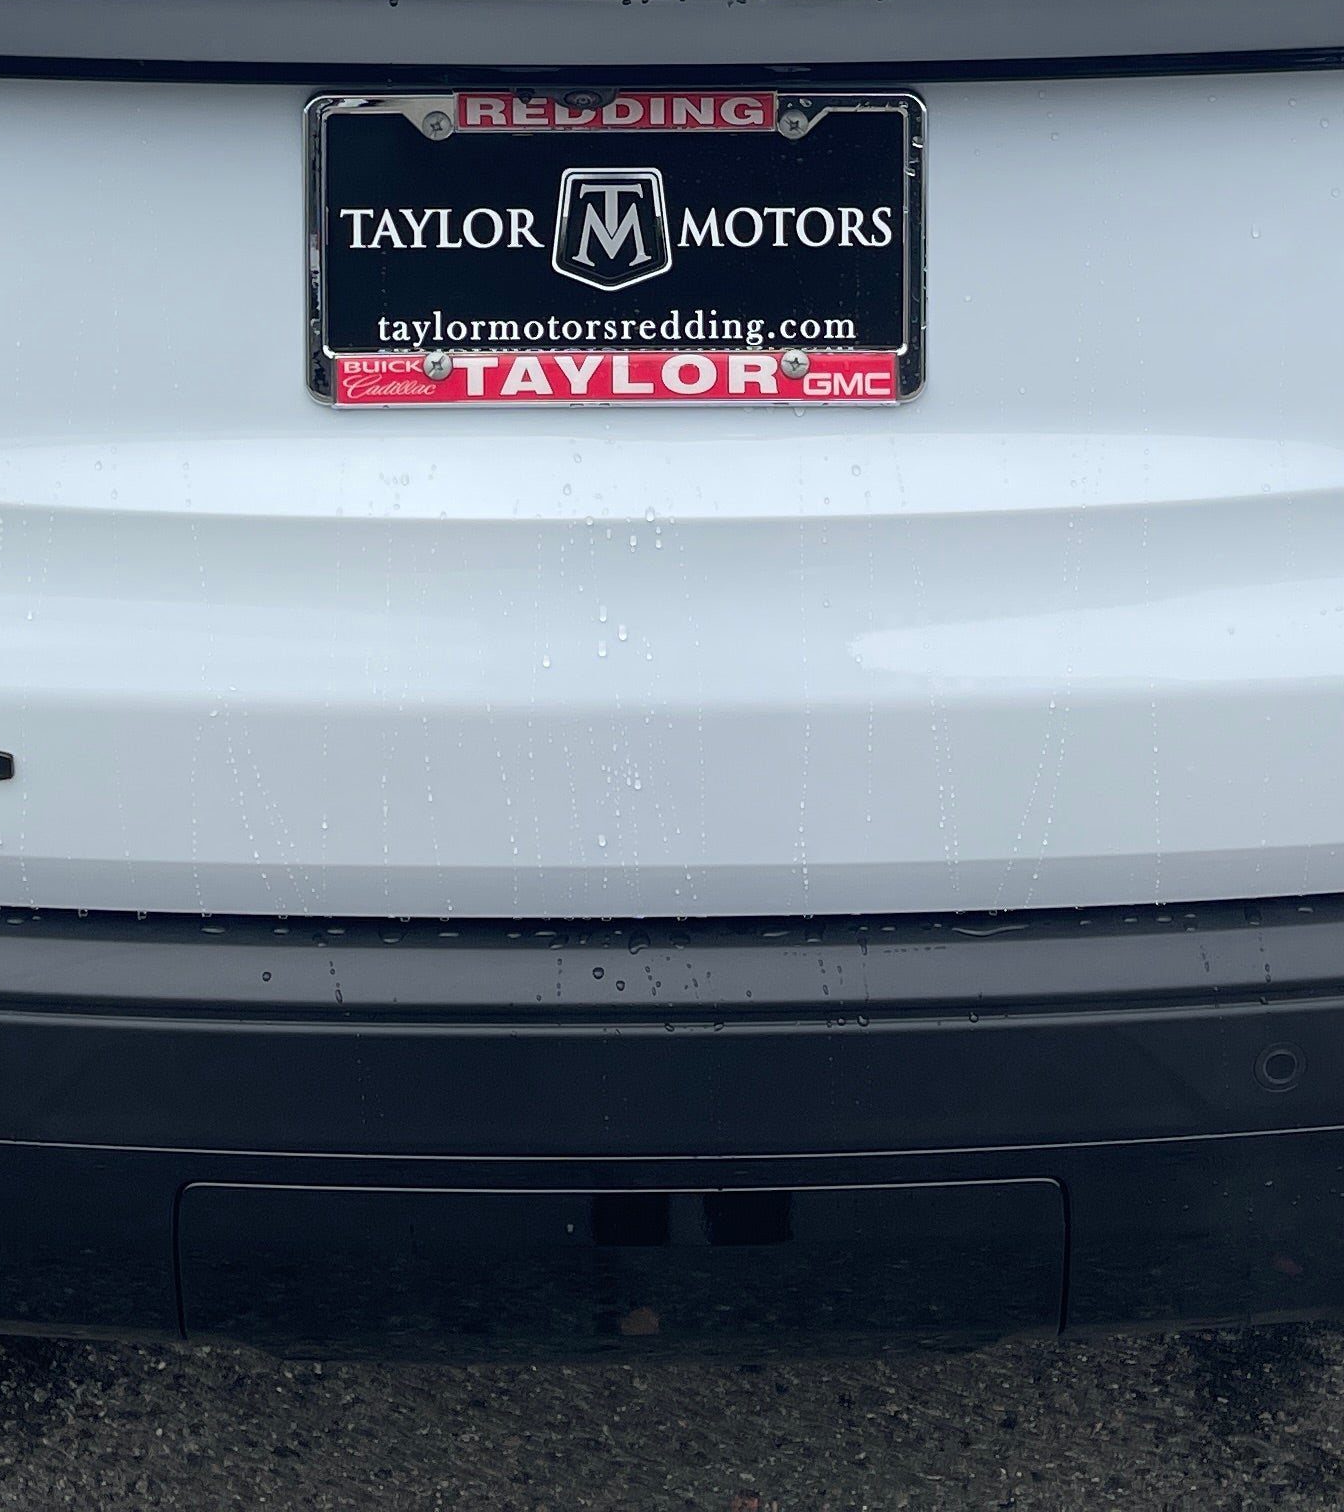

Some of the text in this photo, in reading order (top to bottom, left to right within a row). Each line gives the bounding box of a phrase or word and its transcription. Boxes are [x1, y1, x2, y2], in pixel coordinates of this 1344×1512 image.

[339, 207, 545, 249] TAYLOR
[677, 206, 892, 248] MOTORS
[378, 310, 857, 348] taylormotorsredding.com
[343, 359, 424, 374] BUICK
[452, 354, 779, 396] TAYLOR
[342, 374, 436, 399] Cadillac
[802, 371, 891, 396] GMC
